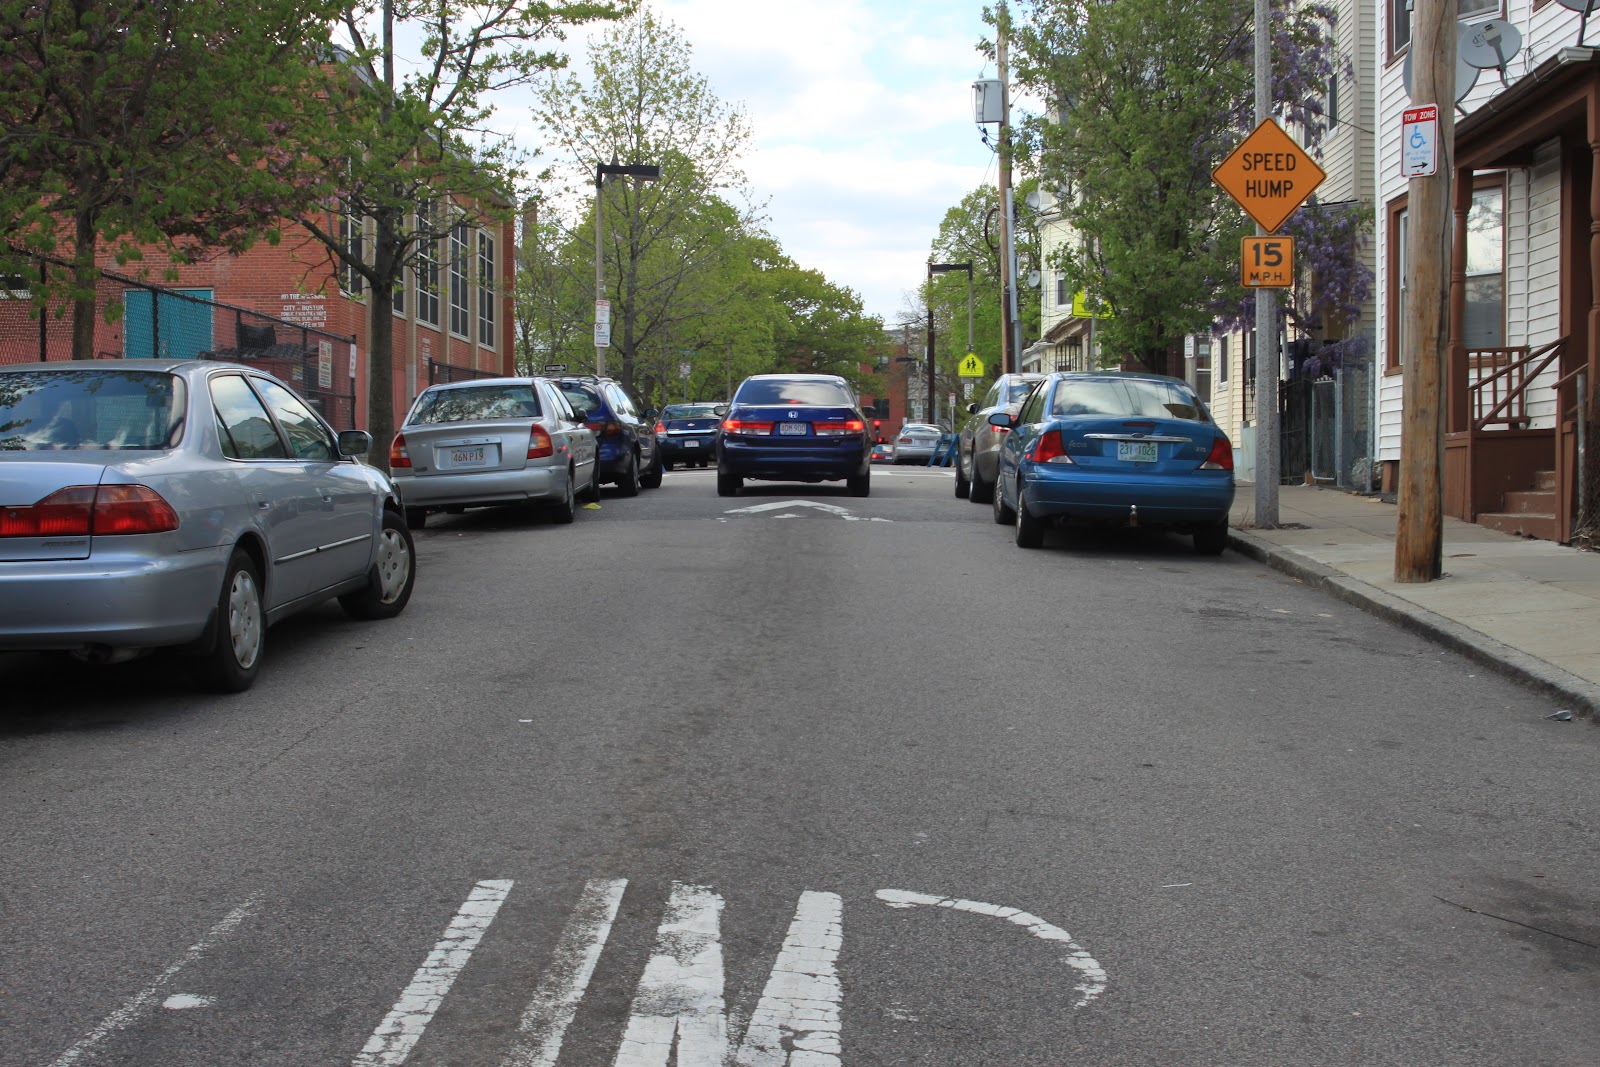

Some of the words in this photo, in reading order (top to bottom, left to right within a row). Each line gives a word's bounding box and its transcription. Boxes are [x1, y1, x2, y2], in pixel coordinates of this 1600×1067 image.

[1404, 112, 1418, 122] TOW
[1419, 109, 1436, 120] ZONE
[1242, 152, 1297, 171] SPEED
[1246, 180, 1294, 198] HUMP
[1252, 242, 1283, 267] 15
[1250, 272, 1285, 281] M.P.H.
[793, 424, 806, 433] 900
[1120, 445, 1132, 455] 231
[1138, 445, 1156, 456] 1026
